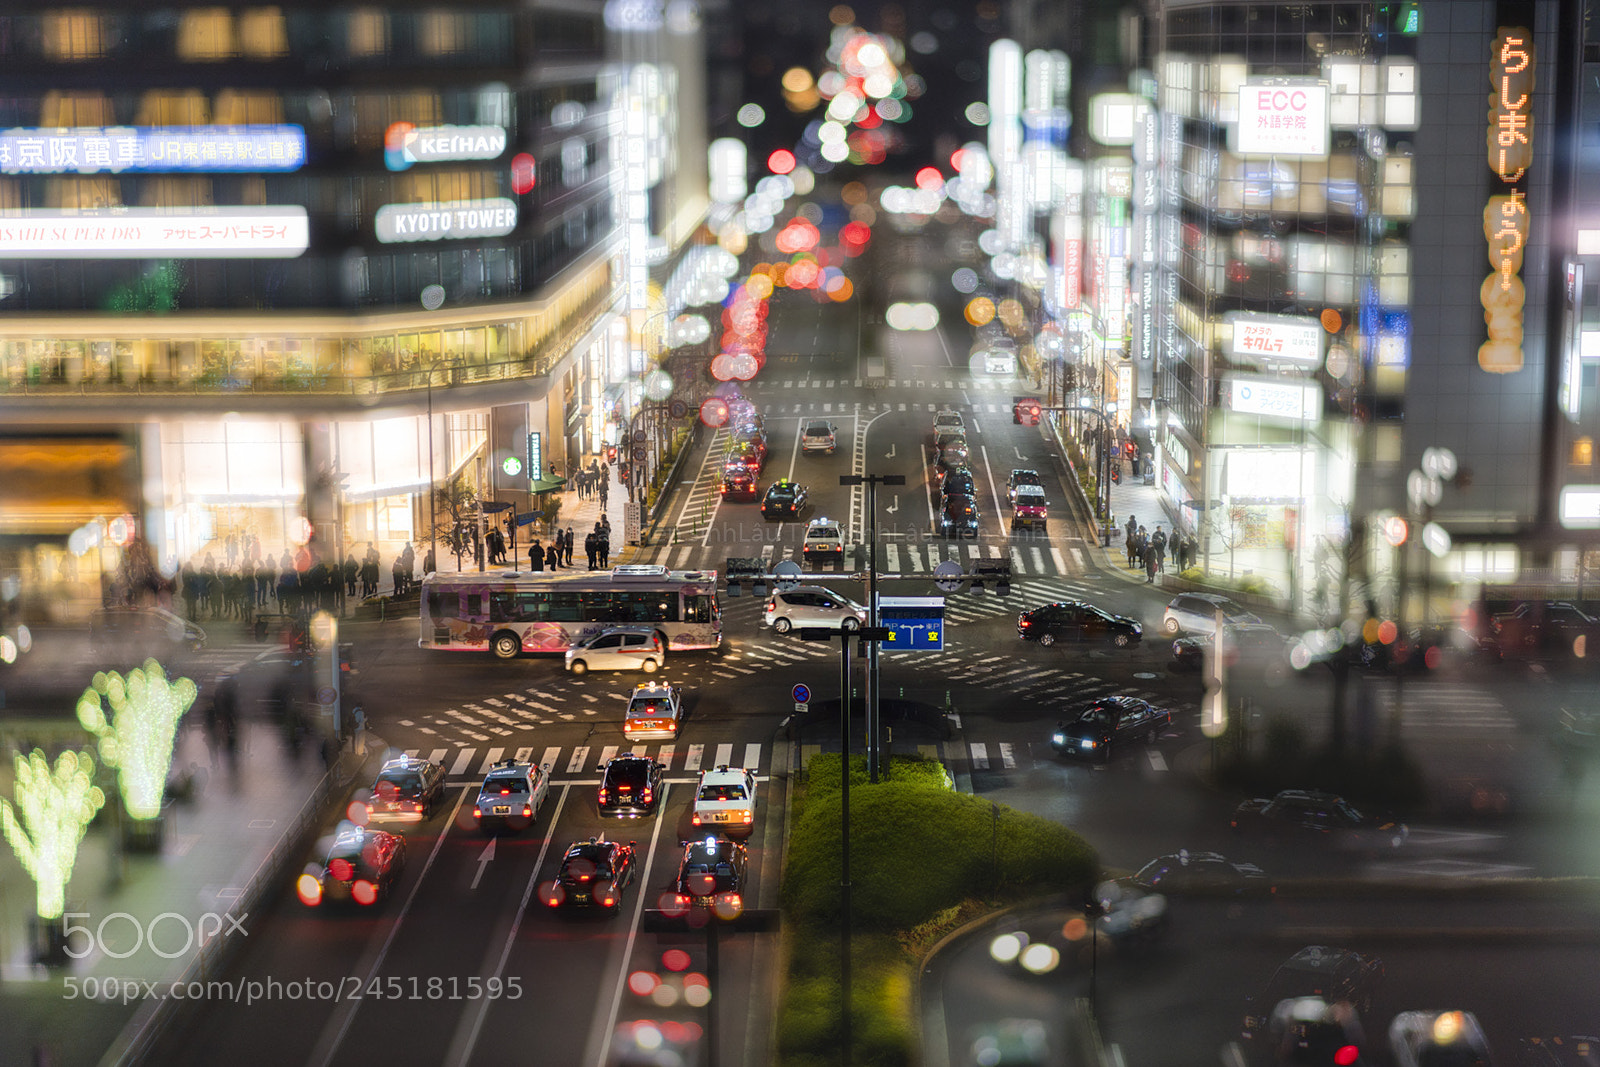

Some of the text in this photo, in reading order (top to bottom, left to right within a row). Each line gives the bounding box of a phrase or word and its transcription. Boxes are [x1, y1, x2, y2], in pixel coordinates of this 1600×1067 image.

[1257, 91, 1307, 112] ECC
[1257, 115, 1307, 130] 外語学院
[421, 134, 505, 154] KEIHAN
[395, 207, 517, 234] KYOTO TOWER
[1244, 326, 1273, 336] カメラの
[1243, 336, 1284, 352] キタムラ
[531, 433, 541, 481] STARBUCKS
